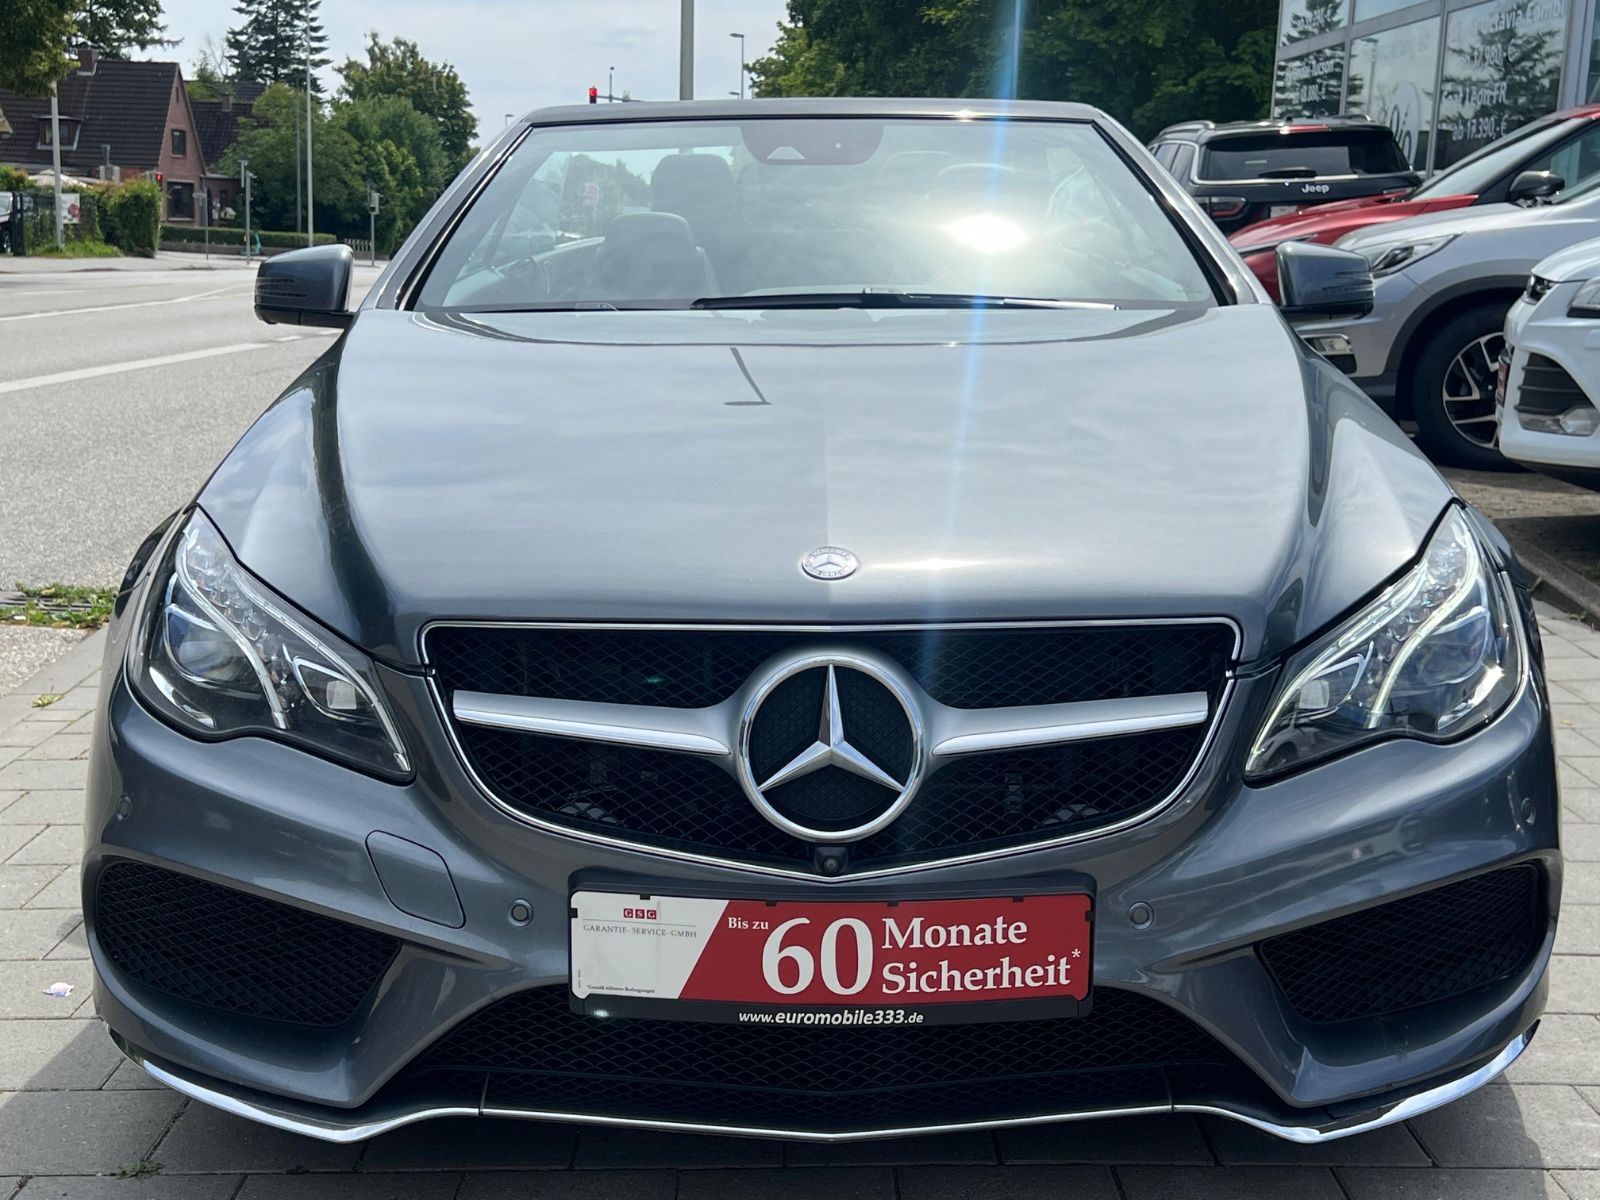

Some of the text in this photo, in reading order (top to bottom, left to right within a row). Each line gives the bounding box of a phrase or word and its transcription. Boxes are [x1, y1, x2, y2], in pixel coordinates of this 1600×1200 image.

[1301, 184, 1330, 193] Jeep
[624, 908, 656, 920] GSG
[728, 916, 769, 930] Bis zu
[881, 915, 1028, 949] Monate
[762, 917, 874, 995] 60
[738, 1009, 924, 1026] www.euromobile333.de
